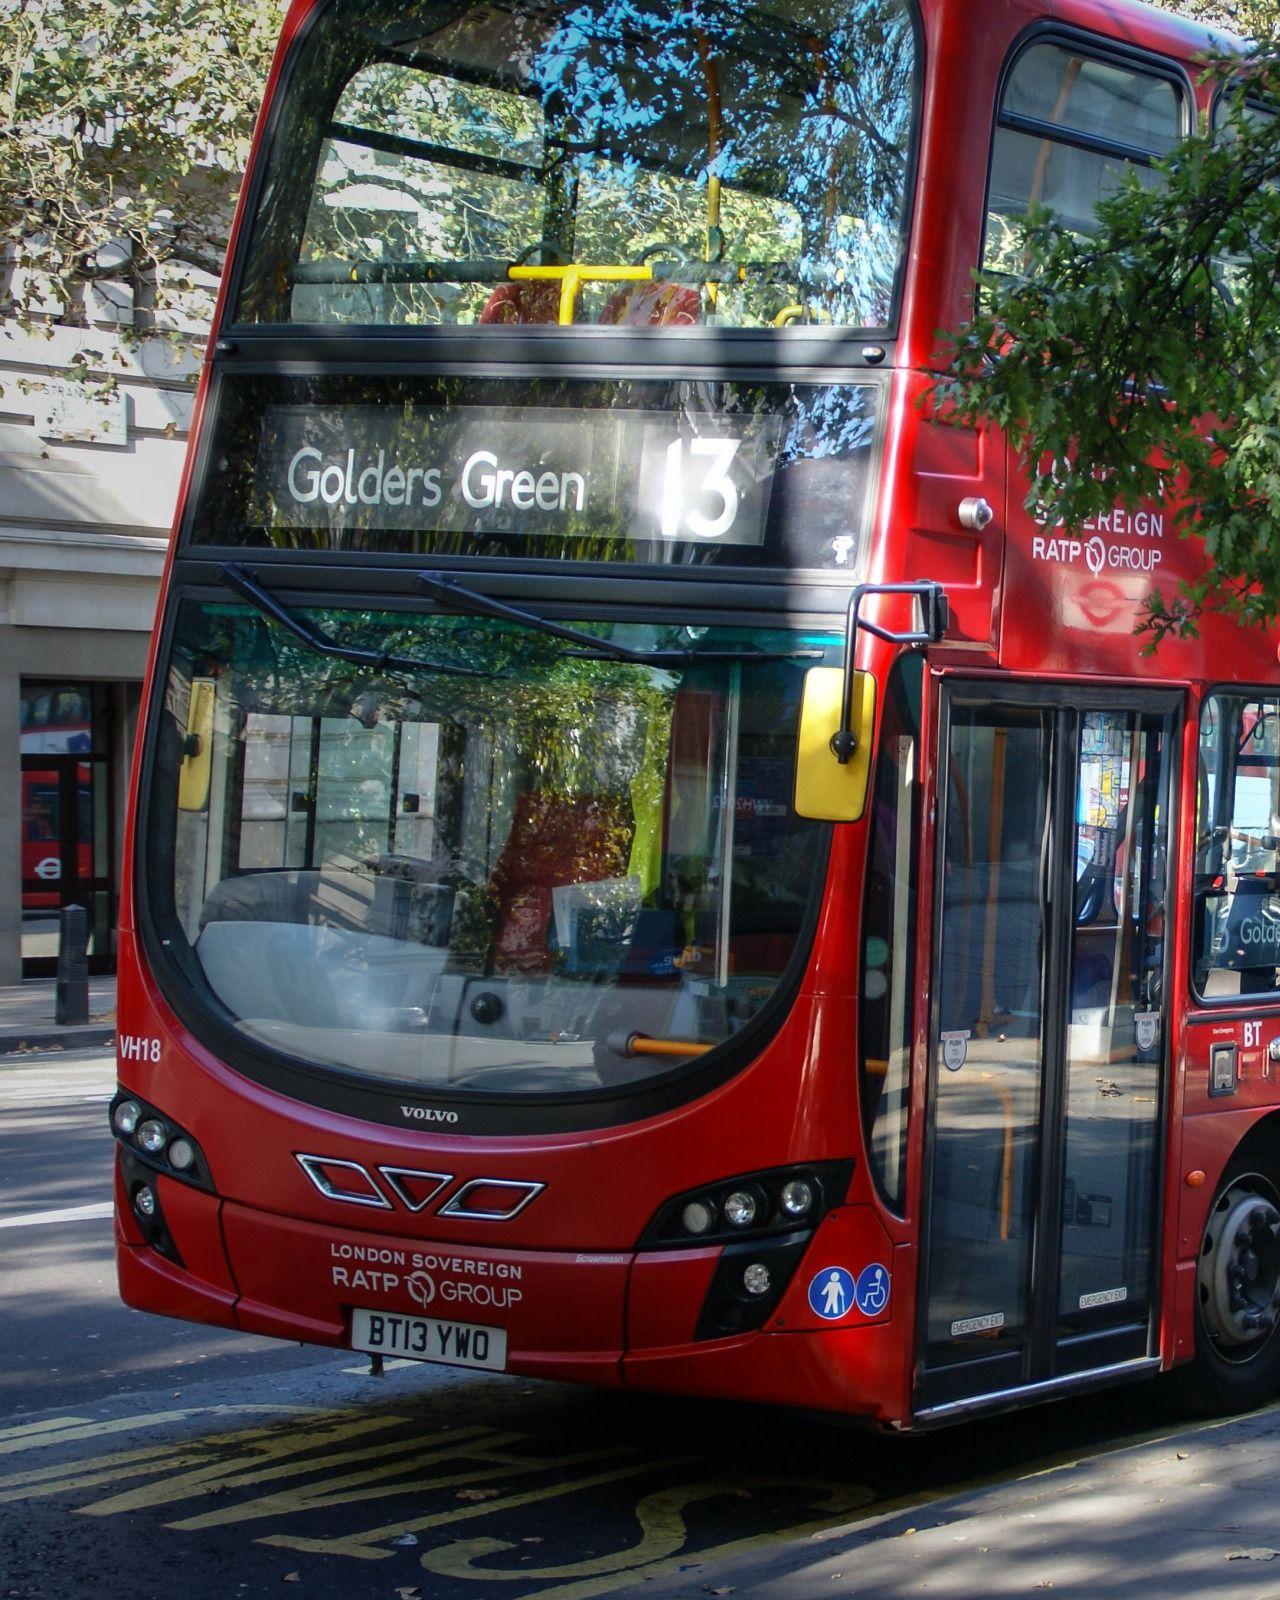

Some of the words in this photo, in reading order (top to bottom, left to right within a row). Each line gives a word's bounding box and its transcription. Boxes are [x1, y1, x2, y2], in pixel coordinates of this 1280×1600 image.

[43, 384, 92, 399] STRAN
[287, 447, 441, 508] Golders
[461, 450, 585, 512] Green
[659, 437, 740, 539] 13
[1034, 500, 1163, 537] SREIGN
[1033, 537, 1081, 562] RATP
[1108, 545, 1161, 571] GROUP
[120, 1034, 161, 1063] VH18
[1244, 1021, 1262, 1048] BT
[400, 1105, 459, 1124] VOLVO
[331, 1243, 405, 1267] LONDON
[412, 1253, 522, 1280] SOVEREIGN
[332, 1266, 399, 1292] RATP
[440, 1281, 522, 1308] GROUP
[368, 1315, 429, 1352] BT13
[436, 1324, 490, 1361] YWO
